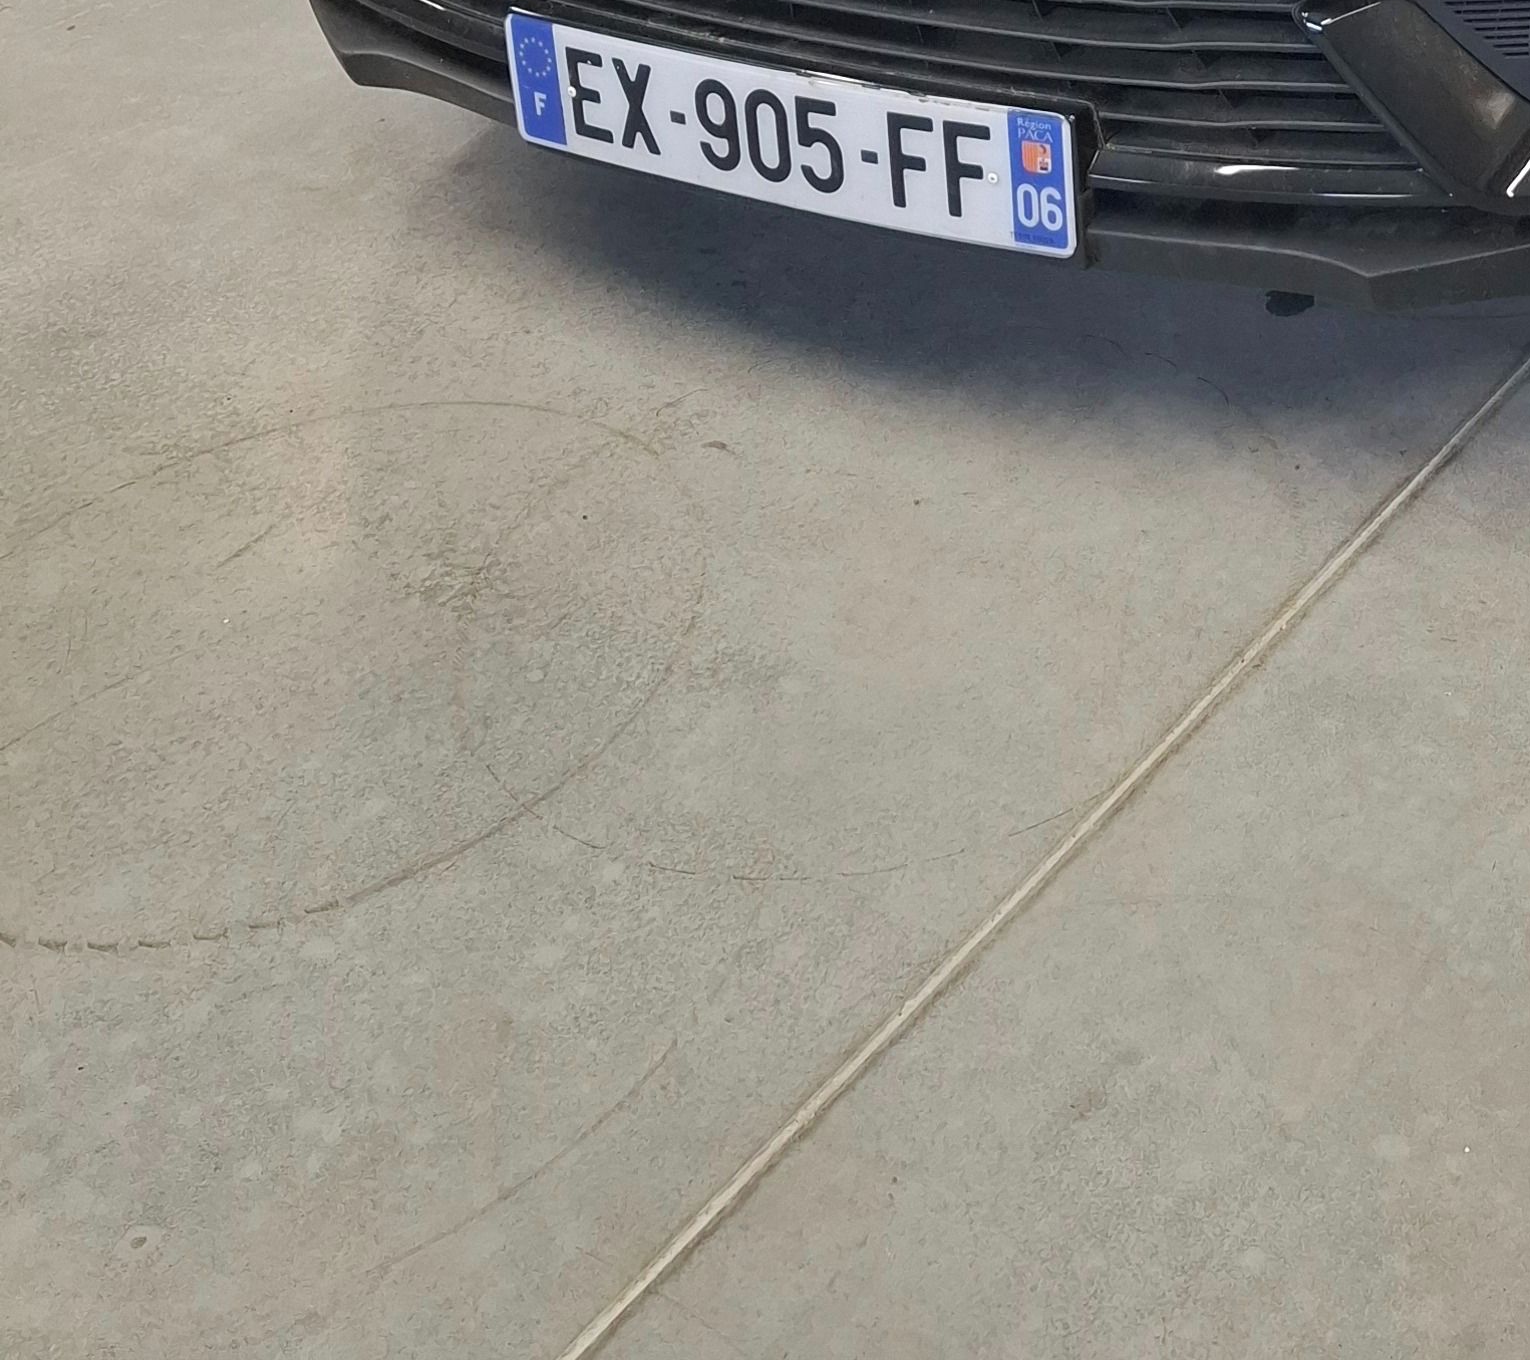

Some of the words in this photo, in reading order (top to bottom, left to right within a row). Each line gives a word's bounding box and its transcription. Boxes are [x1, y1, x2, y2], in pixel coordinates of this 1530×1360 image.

[533, 91, 547, 116] F
[565, 46, 991, 218] EX-905-FF
[1016, 117, 1052, 131] Région
[1017, 127, 1053, 143] PACA
[1016, 183, 1063, 231] 06
